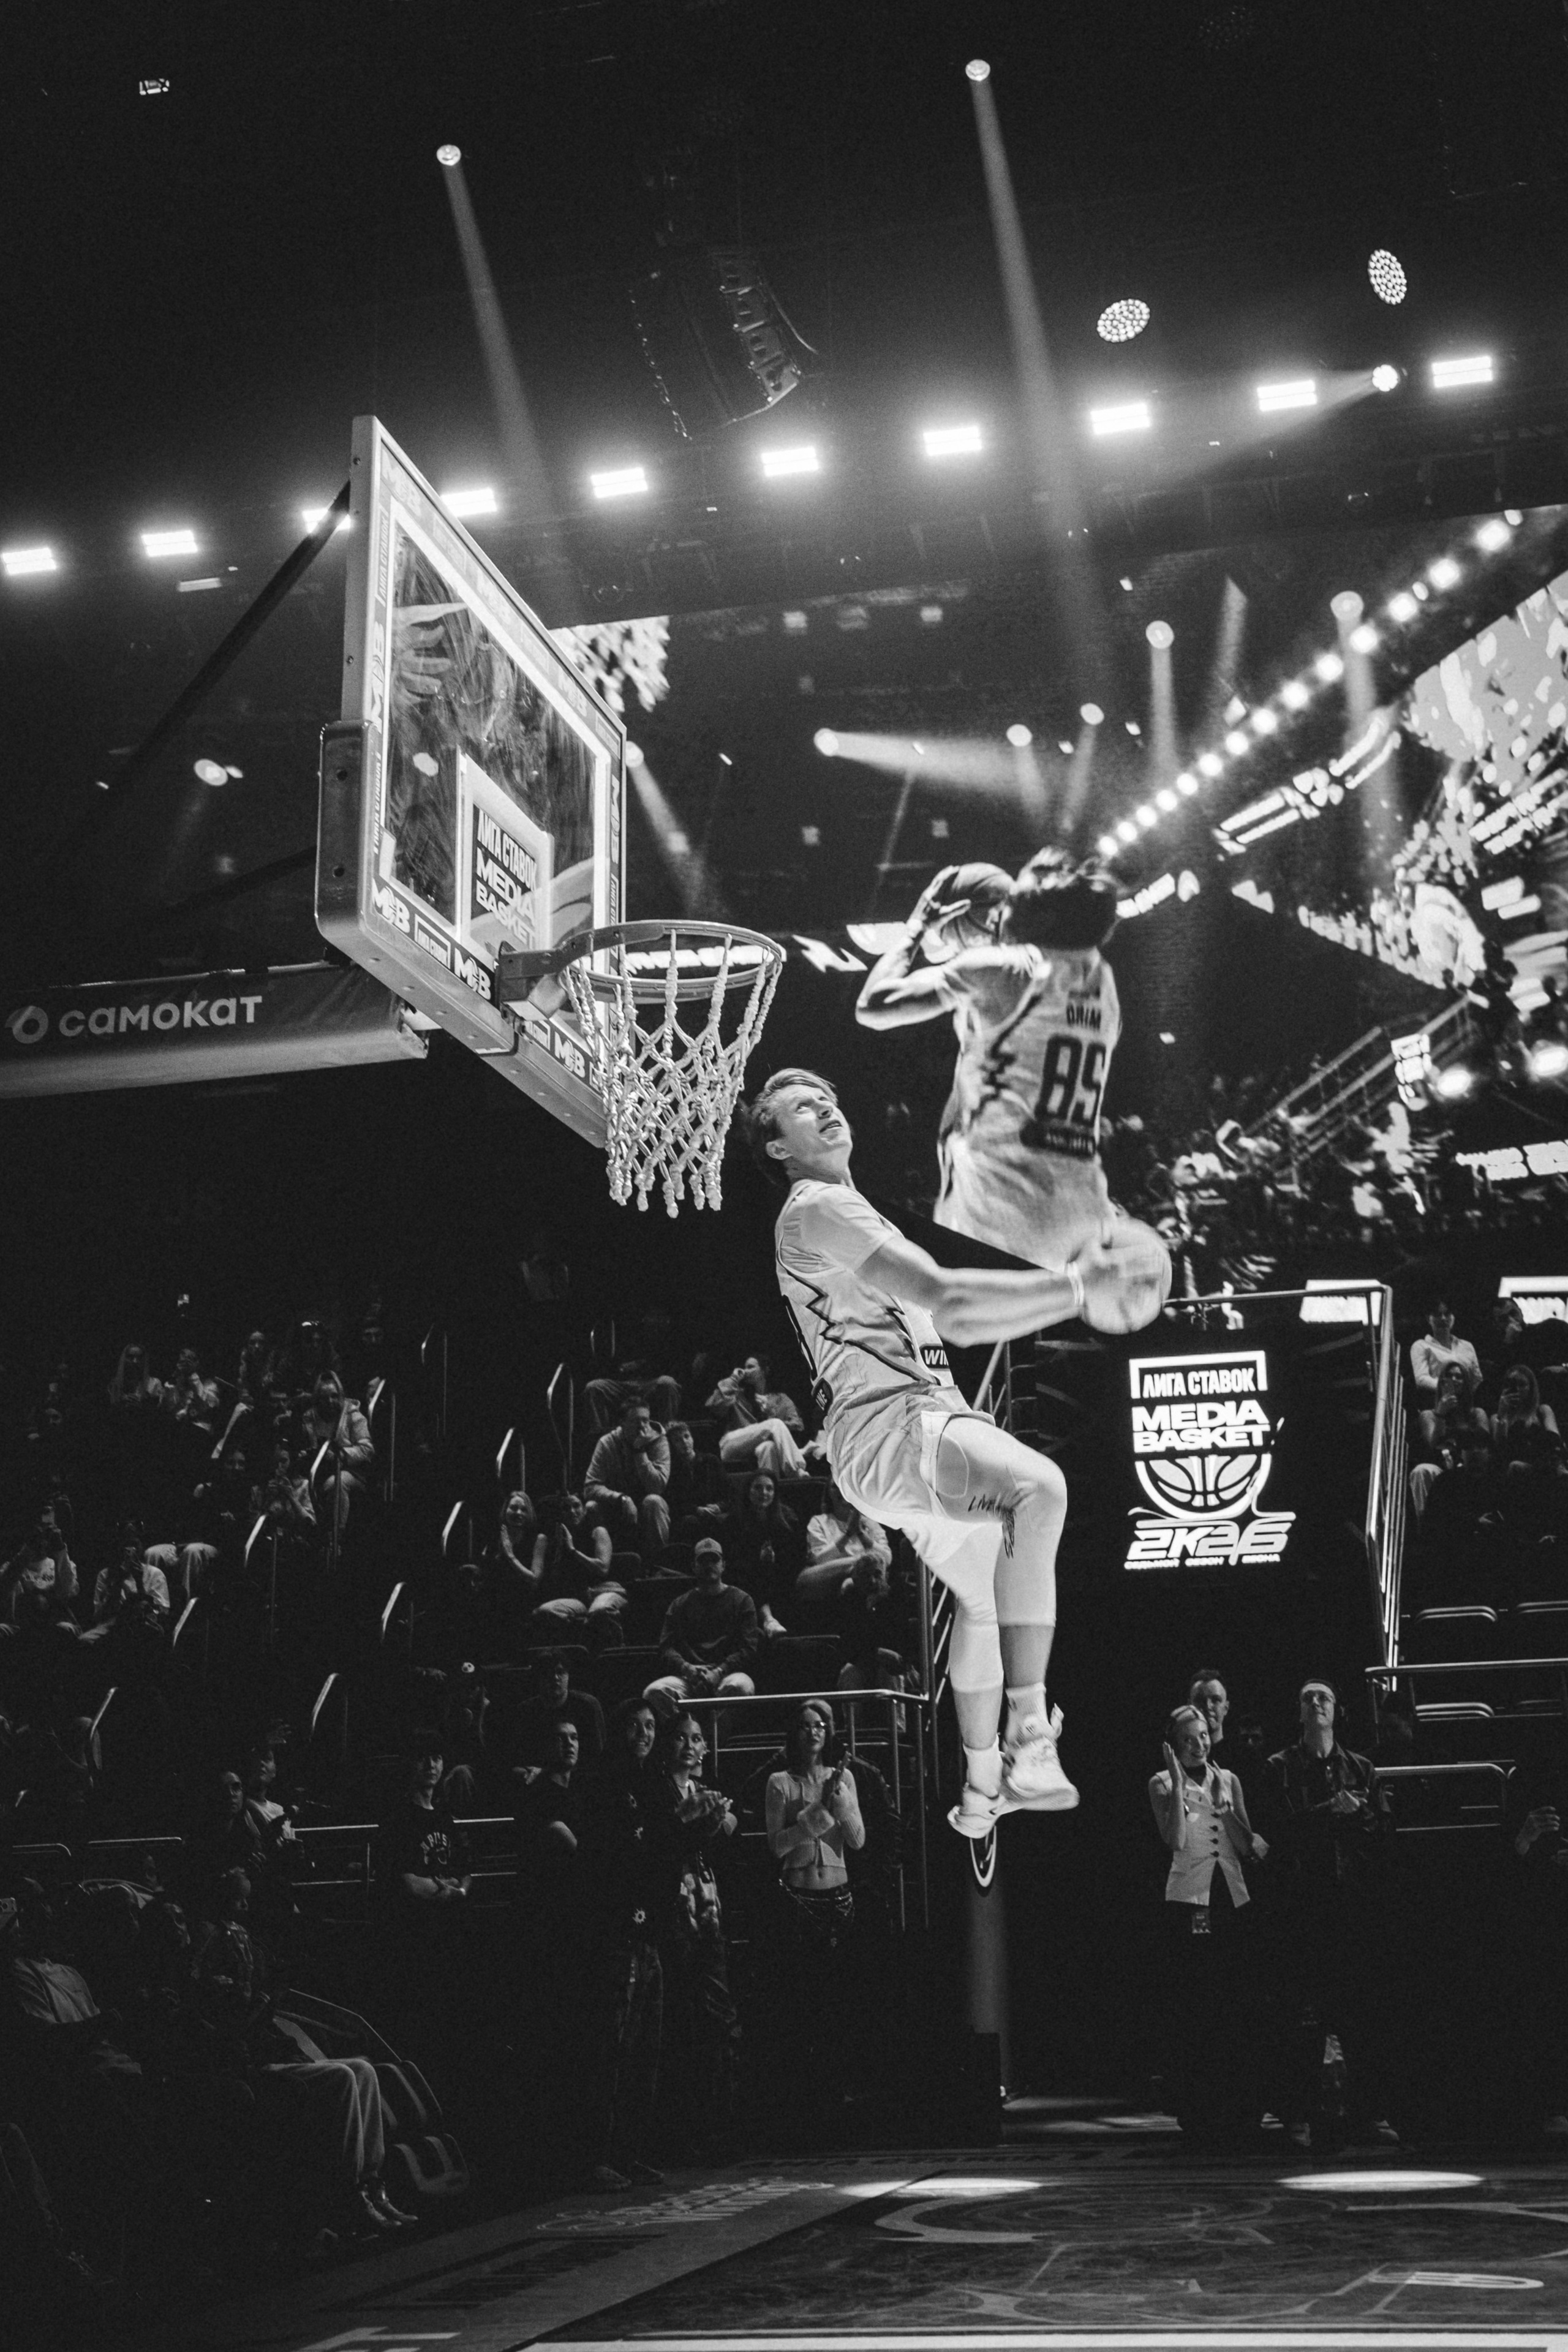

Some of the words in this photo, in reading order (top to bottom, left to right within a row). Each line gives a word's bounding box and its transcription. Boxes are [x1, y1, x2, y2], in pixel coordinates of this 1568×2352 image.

[477, 809, 502, 862] ЛИГА
[502, 832, 537, 892] СТАВОК
[477, 846, 535, 929] MEDIA
[476, 879, 535, 949] BASKET
[59, 995, 263, 1037] самокат
[1143, 1372, 1186, 1398] ЛИГА
[1188, 1368, 1256, 1395] СТАВОК
[1131, 1400, 1270, 1431] MEDIA
[1133, 1424, 1270, 1453] BASKET
